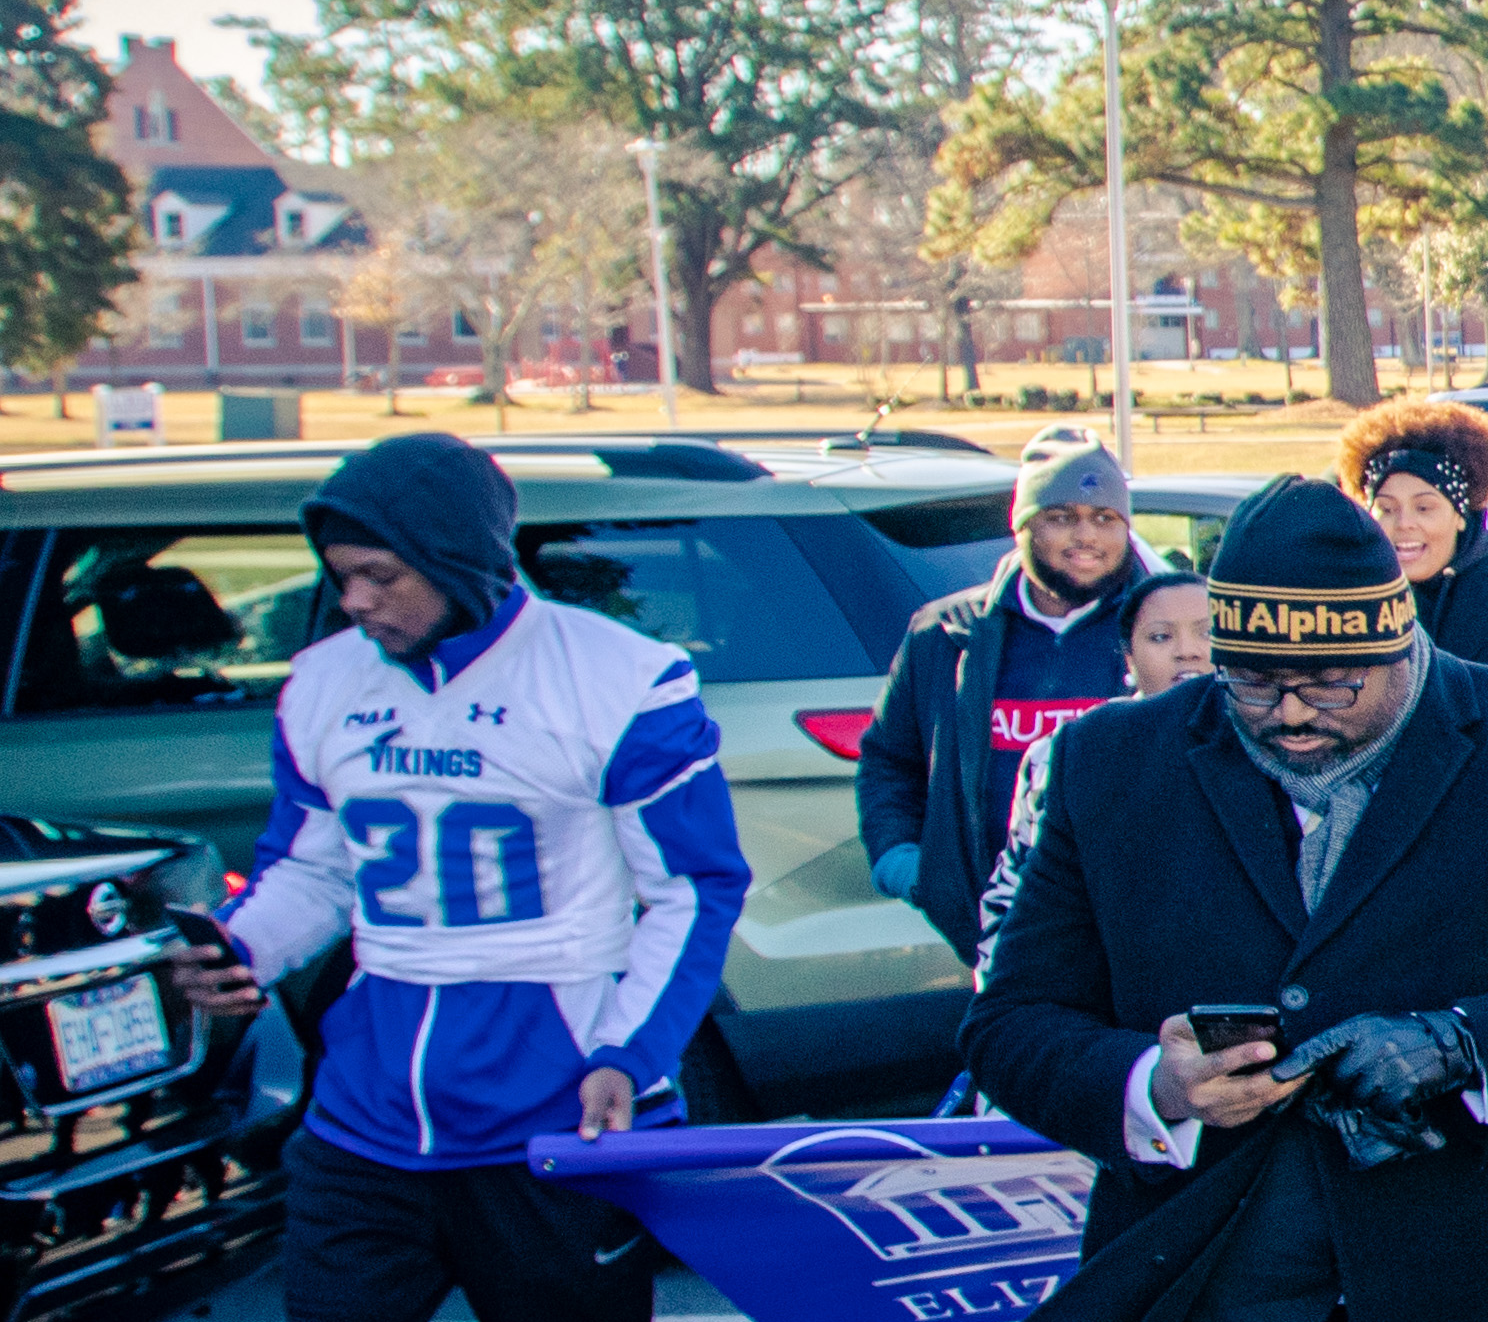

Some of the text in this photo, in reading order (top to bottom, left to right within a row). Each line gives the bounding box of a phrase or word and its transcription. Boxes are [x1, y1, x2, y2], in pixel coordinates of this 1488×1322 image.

[1247, 601, 1368, 642] Alpha
[365, 732, 482, 778] VIKINGS
[339, 797, 545, 927] 20
